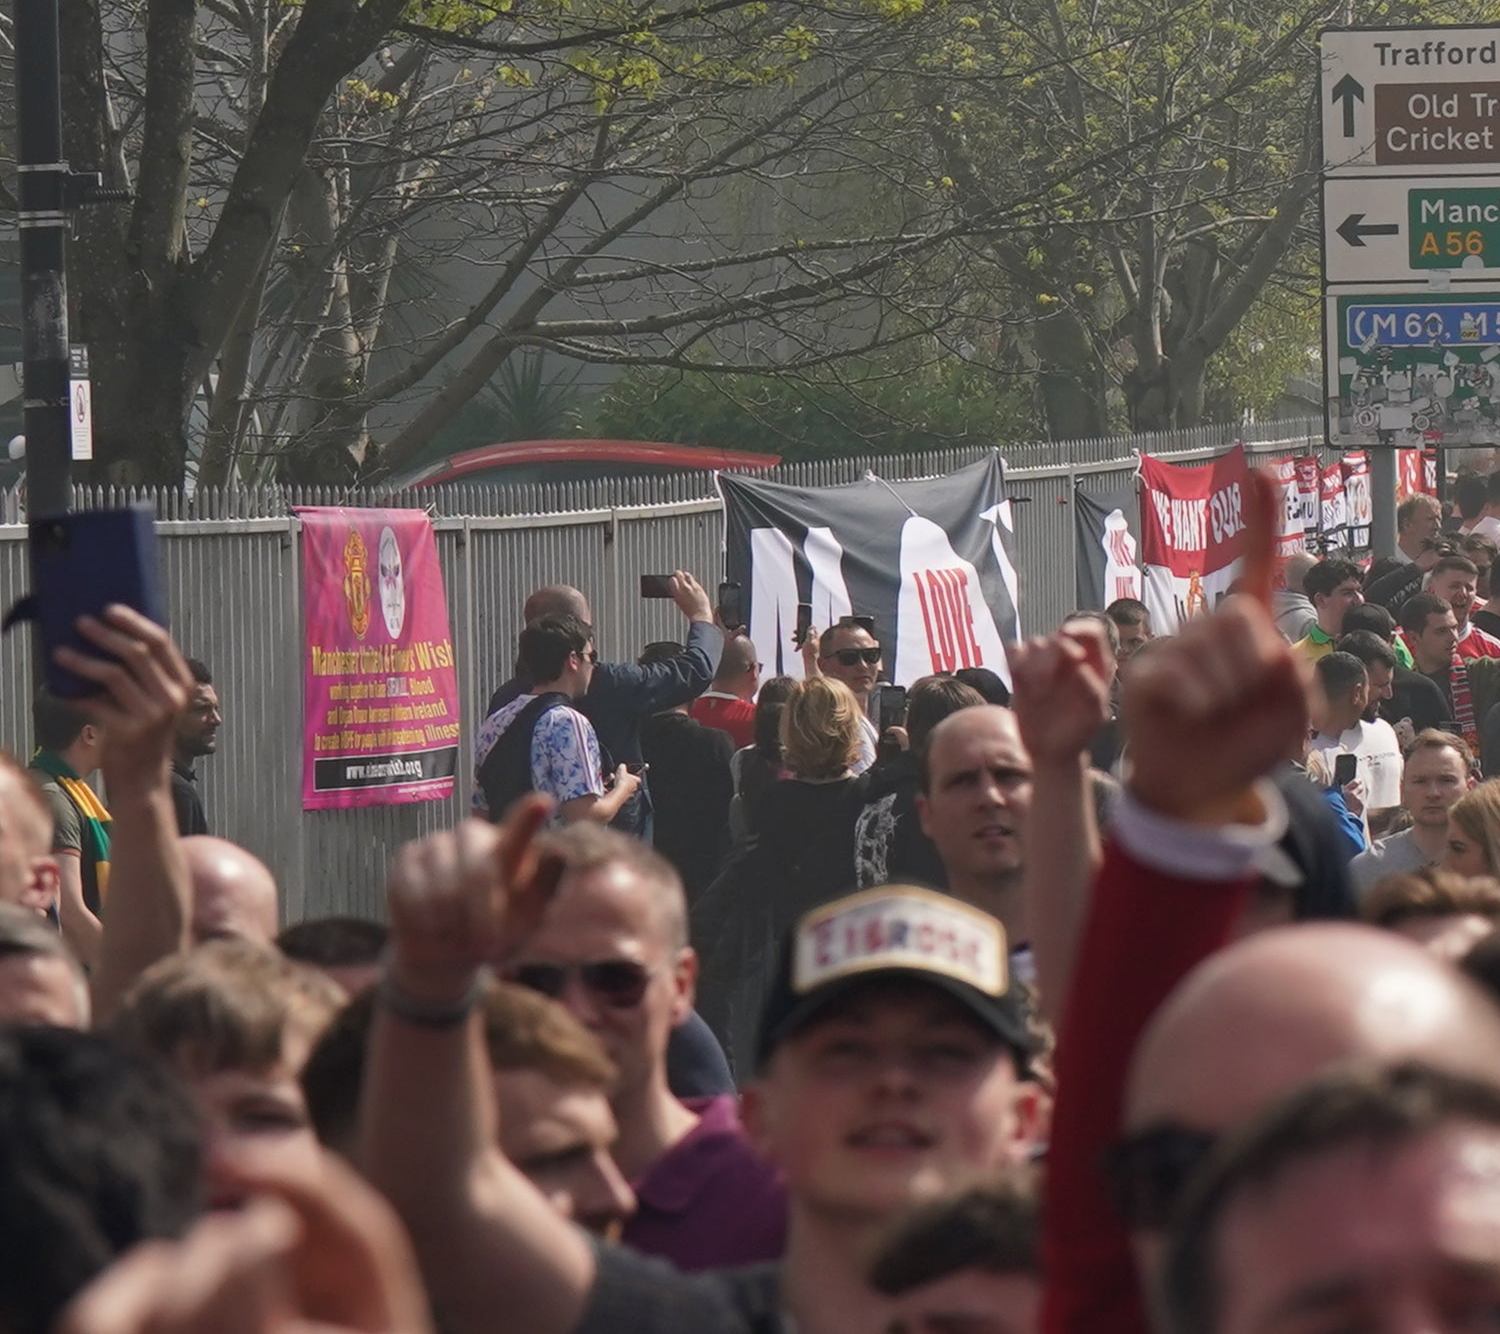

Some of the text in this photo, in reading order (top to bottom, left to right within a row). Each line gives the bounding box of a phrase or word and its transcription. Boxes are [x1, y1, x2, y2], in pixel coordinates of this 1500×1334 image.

[1374, 40, 1497, 66] Trafford
[1408, 93, 1458, 119] Old
[1386, 125, 1494, 152] Cricket
[1209, 481, 1247, 544] OUR
[912, 568, 983, 674] LOVE
[414, 638, 454, 671] Wish
[413, 698, 448, 720] Ireland
